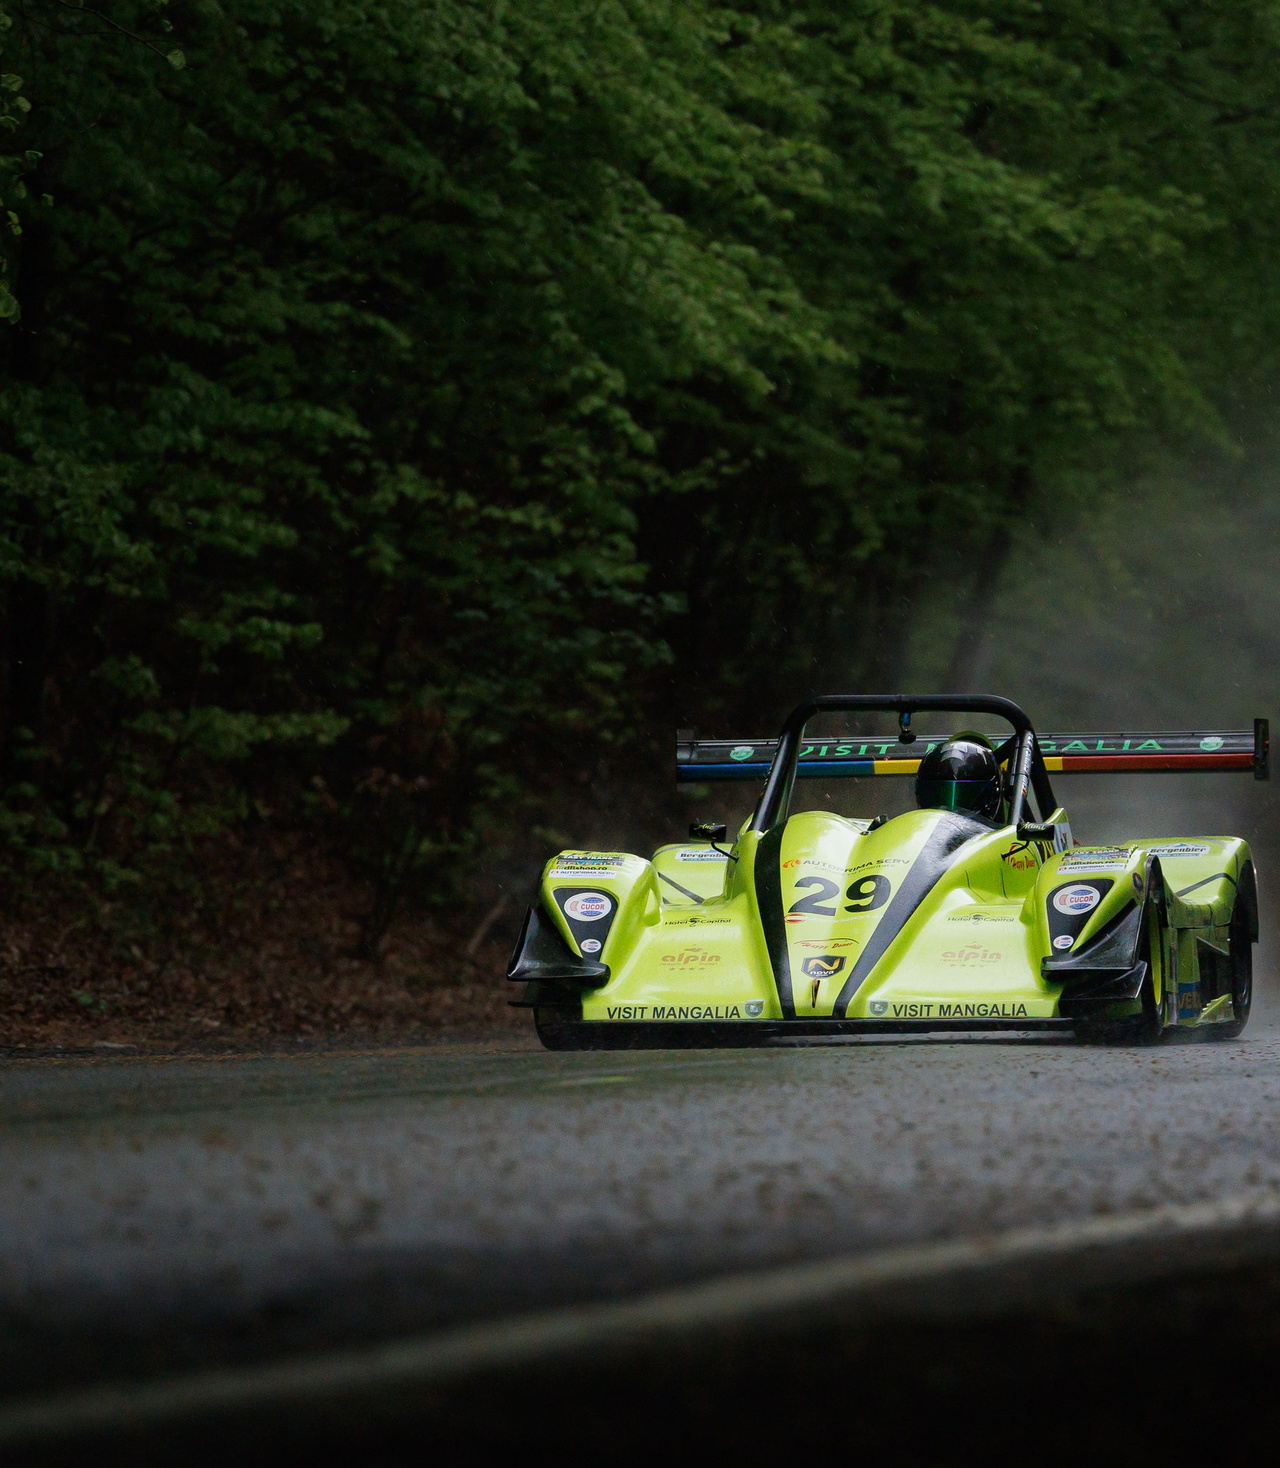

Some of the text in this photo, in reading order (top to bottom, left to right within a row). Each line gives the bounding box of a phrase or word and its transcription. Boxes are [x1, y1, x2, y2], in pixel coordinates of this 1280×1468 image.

[803, 859, 873, 872] AUTOPRIMA
[788, 874, 892, 917] 29
[1069, 895, 1094, 904] CUCOR
[580, 903, 605, 911] CUCOR
[661, 951, 721, 965] alpin
[941, 949, 1002, 962] alpin
[606, 1006, 741, 1019] VISIT MANGALIA
[893, 1003, 1028, 1017] VISIT MANGALIA
